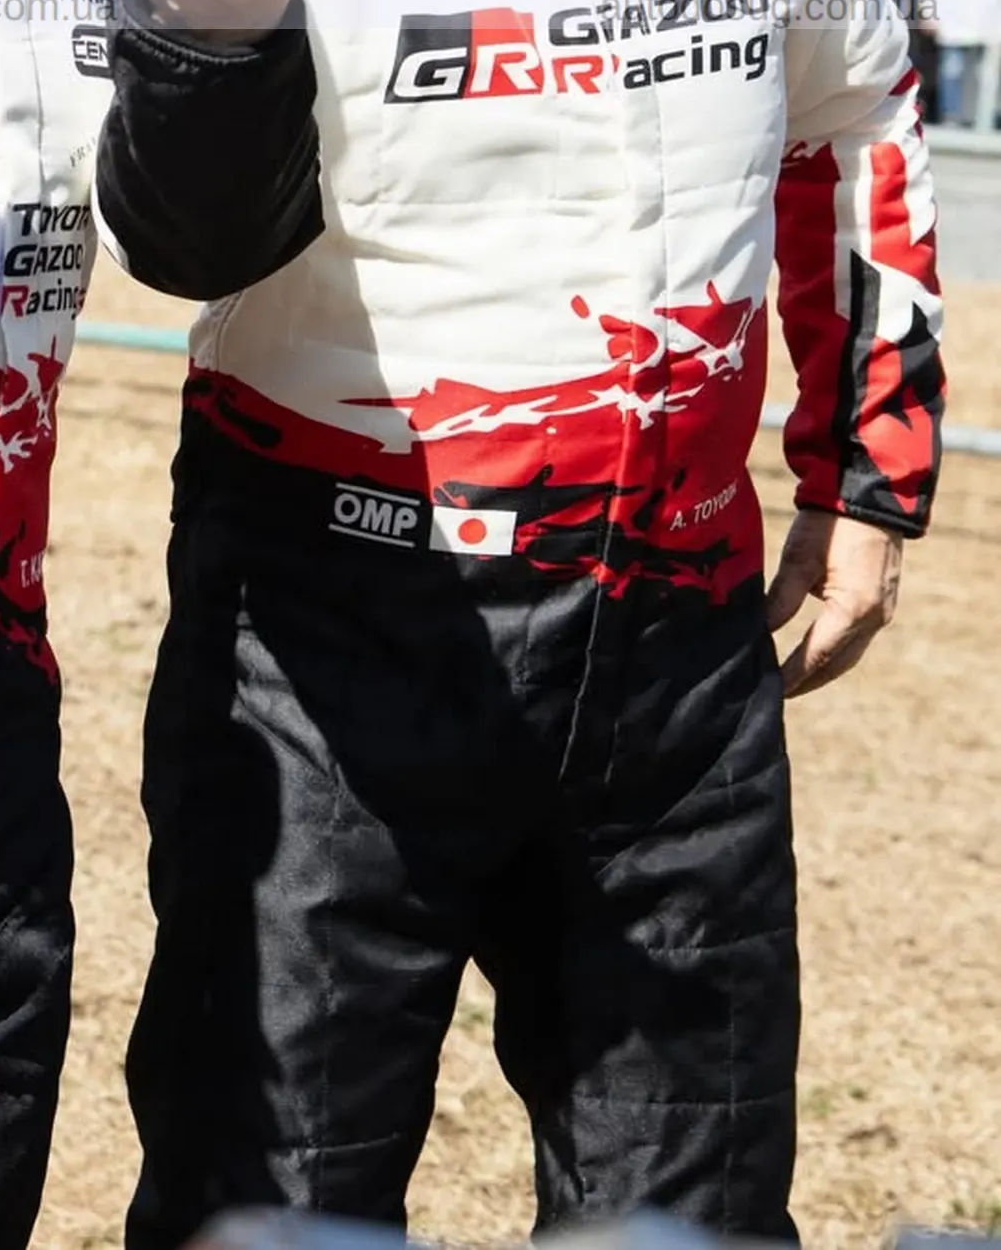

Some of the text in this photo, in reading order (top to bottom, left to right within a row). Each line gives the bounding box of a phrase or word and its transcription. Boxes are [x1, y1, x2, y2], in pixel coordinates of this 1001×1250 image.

[393, 41, 542, 98] GR
[334, 492, 418, 537] OMP
[669, 509, 687, 531] A.
